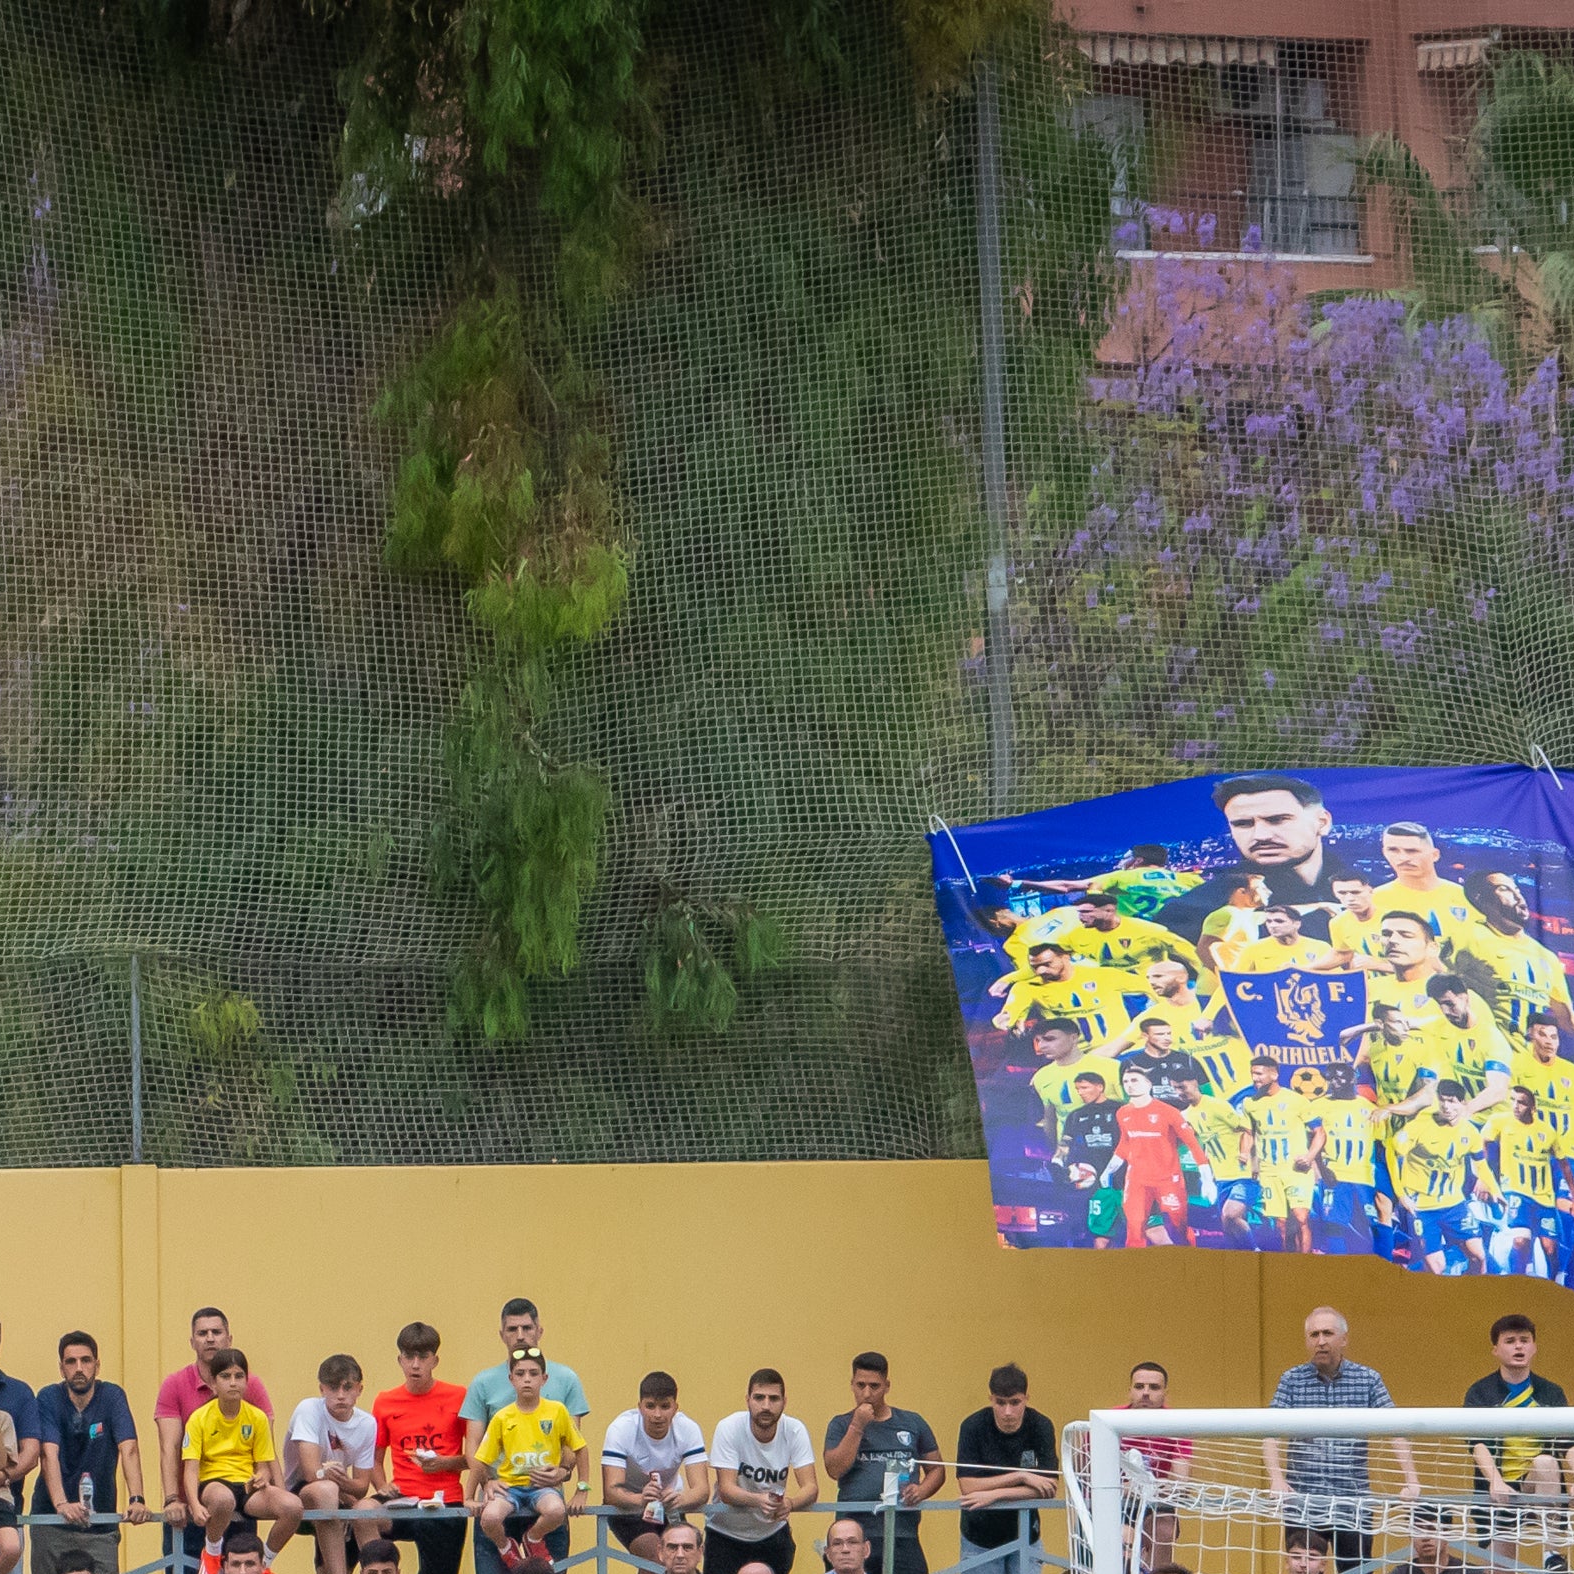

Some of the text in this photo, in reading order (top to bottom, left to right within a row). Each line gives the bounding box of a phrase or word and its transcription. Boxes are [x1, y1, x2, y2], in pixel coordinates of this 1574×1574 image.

[1327, 981, 1355, 1003] F.
[401, 1432, 443, 1451] CRC
[510, 1450, 551, 1467] CRC
